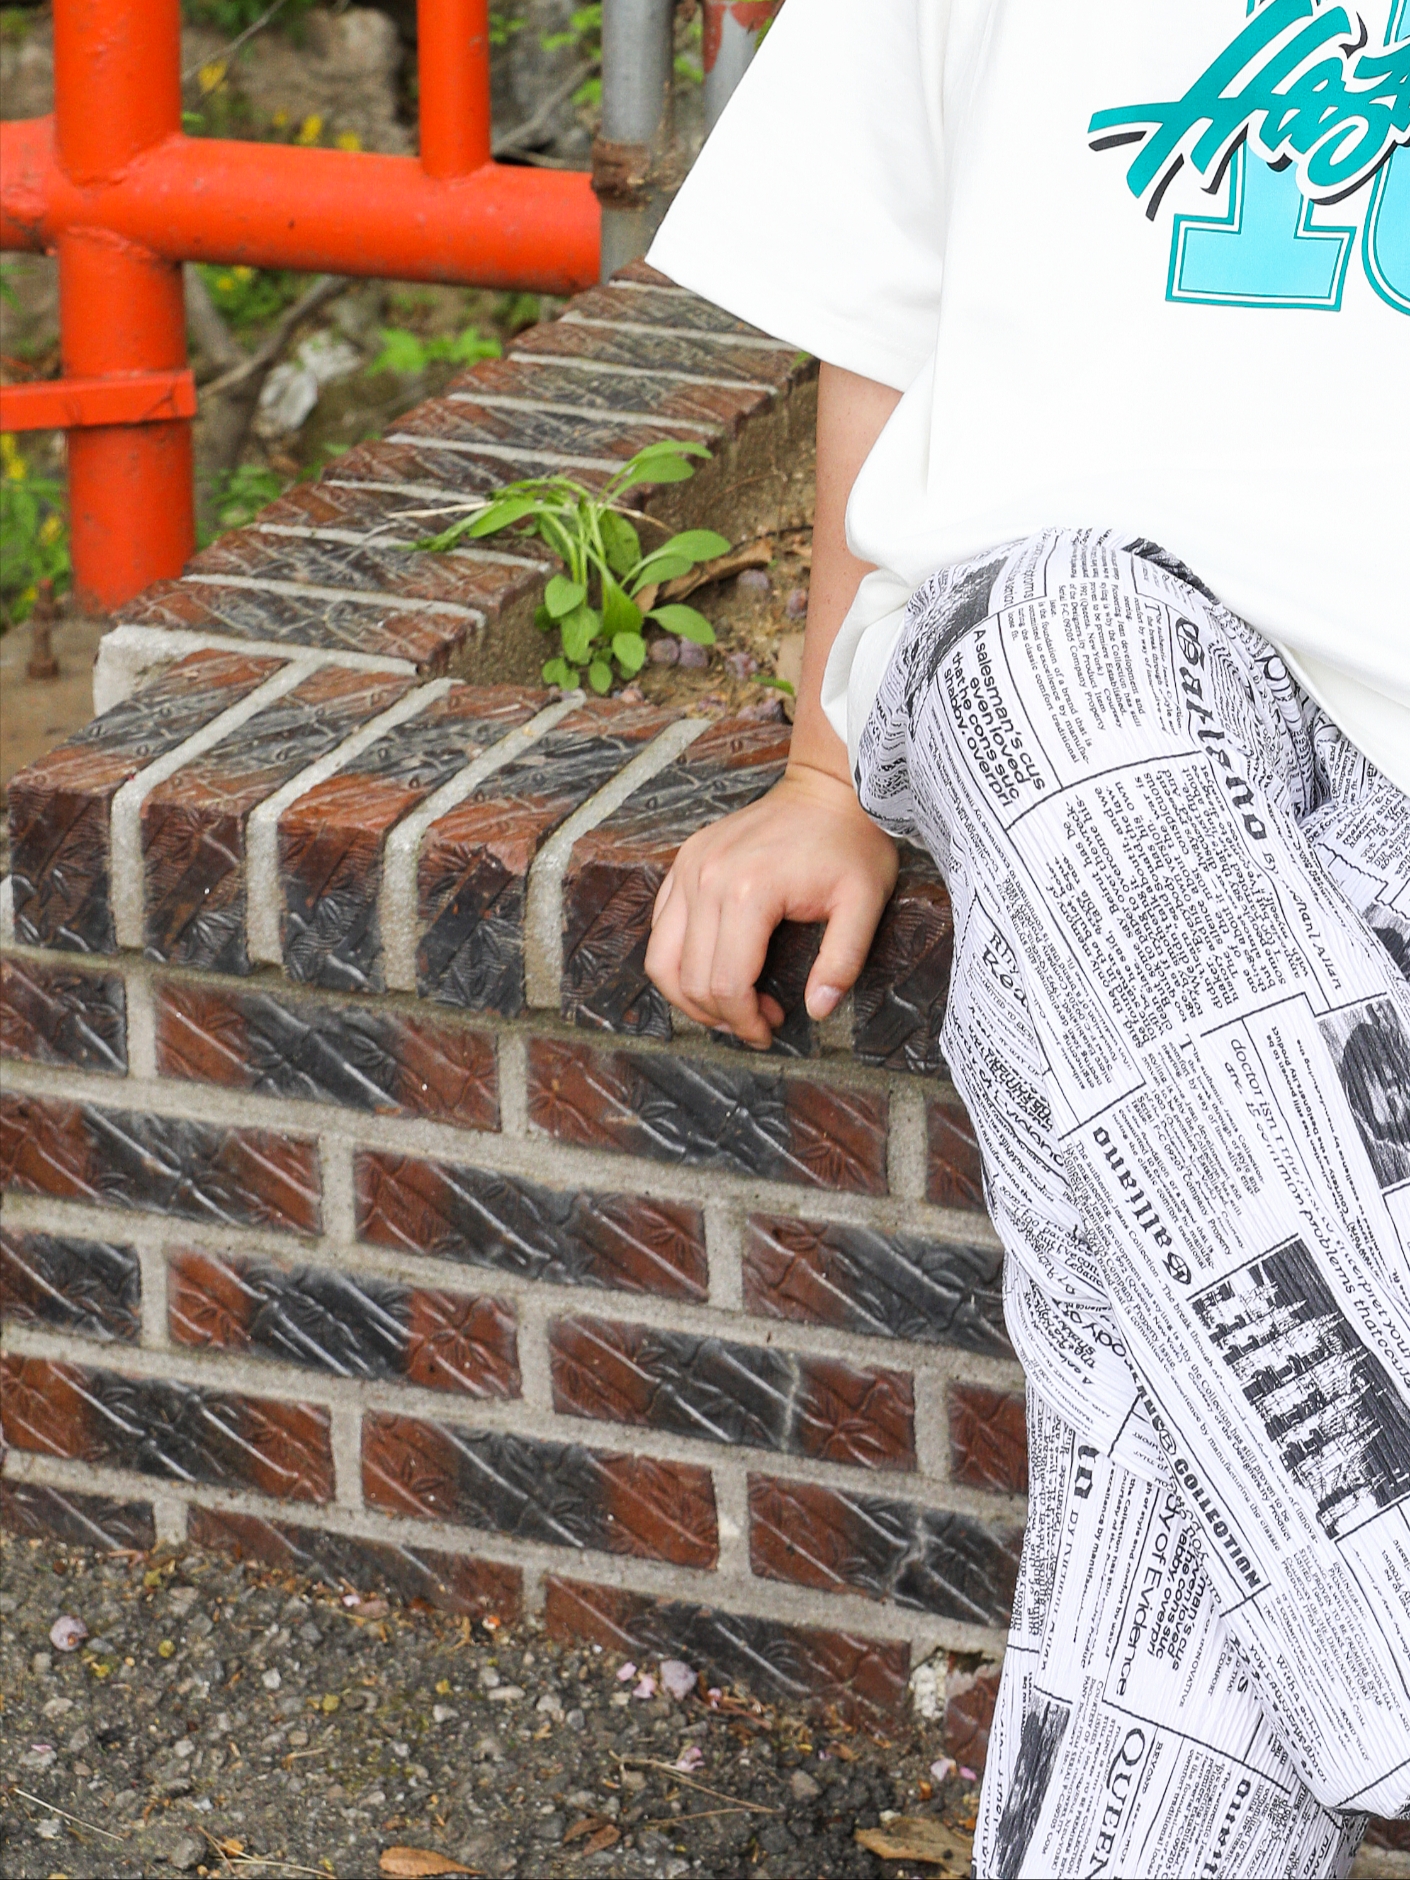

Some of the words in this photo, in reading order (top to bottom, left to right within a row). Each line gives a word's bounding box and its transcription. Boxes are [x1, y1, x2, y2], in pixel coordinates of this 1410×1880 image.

[952, 651, 966, 688] that
[957, 685, 972, 710] he
[968, 713, 997, 761] cons
[970, 677, 994, 726] even
[989, 726, 1031, 784] loved
[994, 763, 1019, 802] suc
[1019, 752, 1045, 790] cus
[1115, 781, 1135, 811] own
[1143, 772, 1189, 855] conspicuous
[1063, 821, 1076, 840] be
[1103, 808, 1124, 835] and
[1160, 825, 1175, 849] the
[1075, 842, 1093, 868] has
[1090, 825, 1130, 893] overcome
[1147, 844, 1164, 870] has
[1092, 871, 1120, 915] Beirut
[1197, 900, 1223, 945] silence
[1215, 911, 1230, 934] the
[1222, 906, 1246, 945] about
[1133, 943, 1156, 978] some
[1221, 951, 1238, 979] The
[1227, 945, 1241, 958] of
[1153, 981, 1171, 1008] But
[1243, 969, 1258, 994] one
[1260, 965, 1276, 989] but
[1092, 1126, 1192, 1286] Galliano
[1170, 1458, 1261, 1589] COLLECTION
[1116, 1567, 1163, 1696] Evidence
